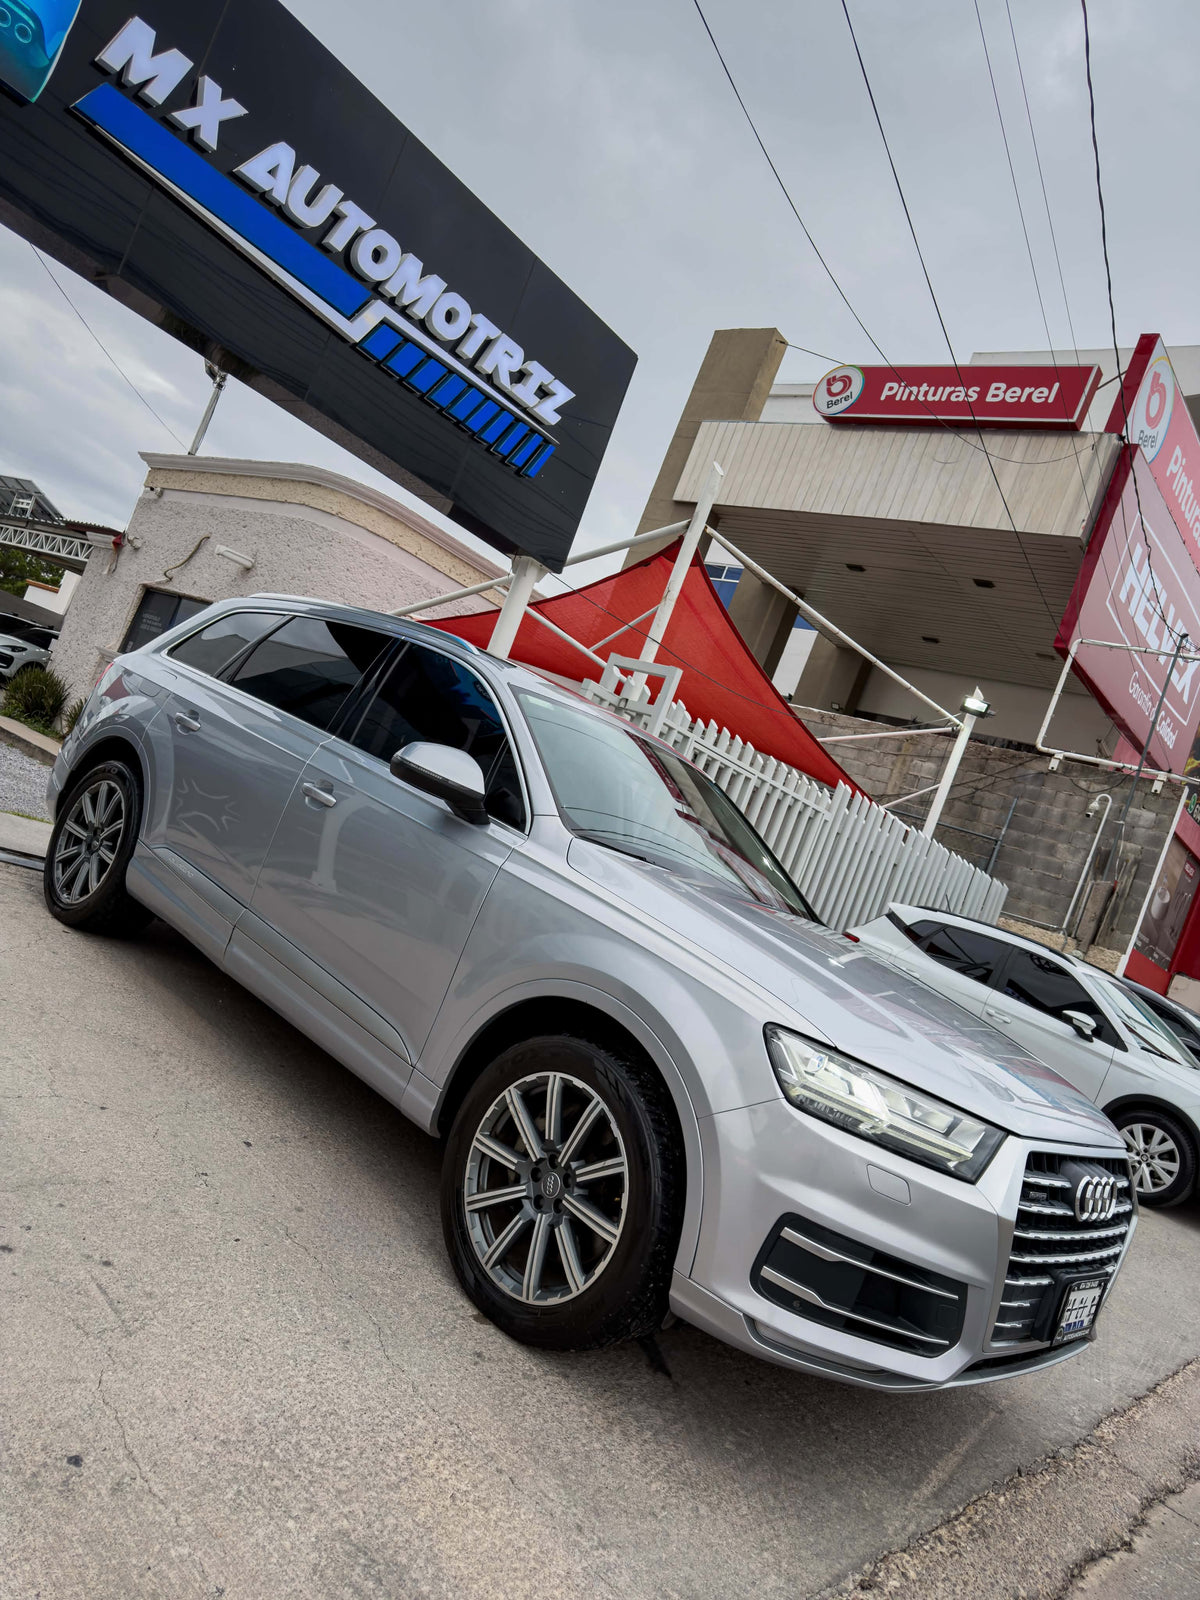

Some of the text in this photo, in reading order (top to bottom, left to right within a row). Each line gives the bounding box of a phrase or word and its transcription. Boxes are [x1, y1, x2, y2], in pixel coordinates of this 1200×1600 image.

[95, 16, 576, 426] MX AUTOMOTRIZ
[826, 391, 853, 409] Berel
[880, 382, 1060, 403] Pinturas Berel
[1138, 429, 1159, 449] Berel
[1119, 542, 1200, 704] HELVEX
